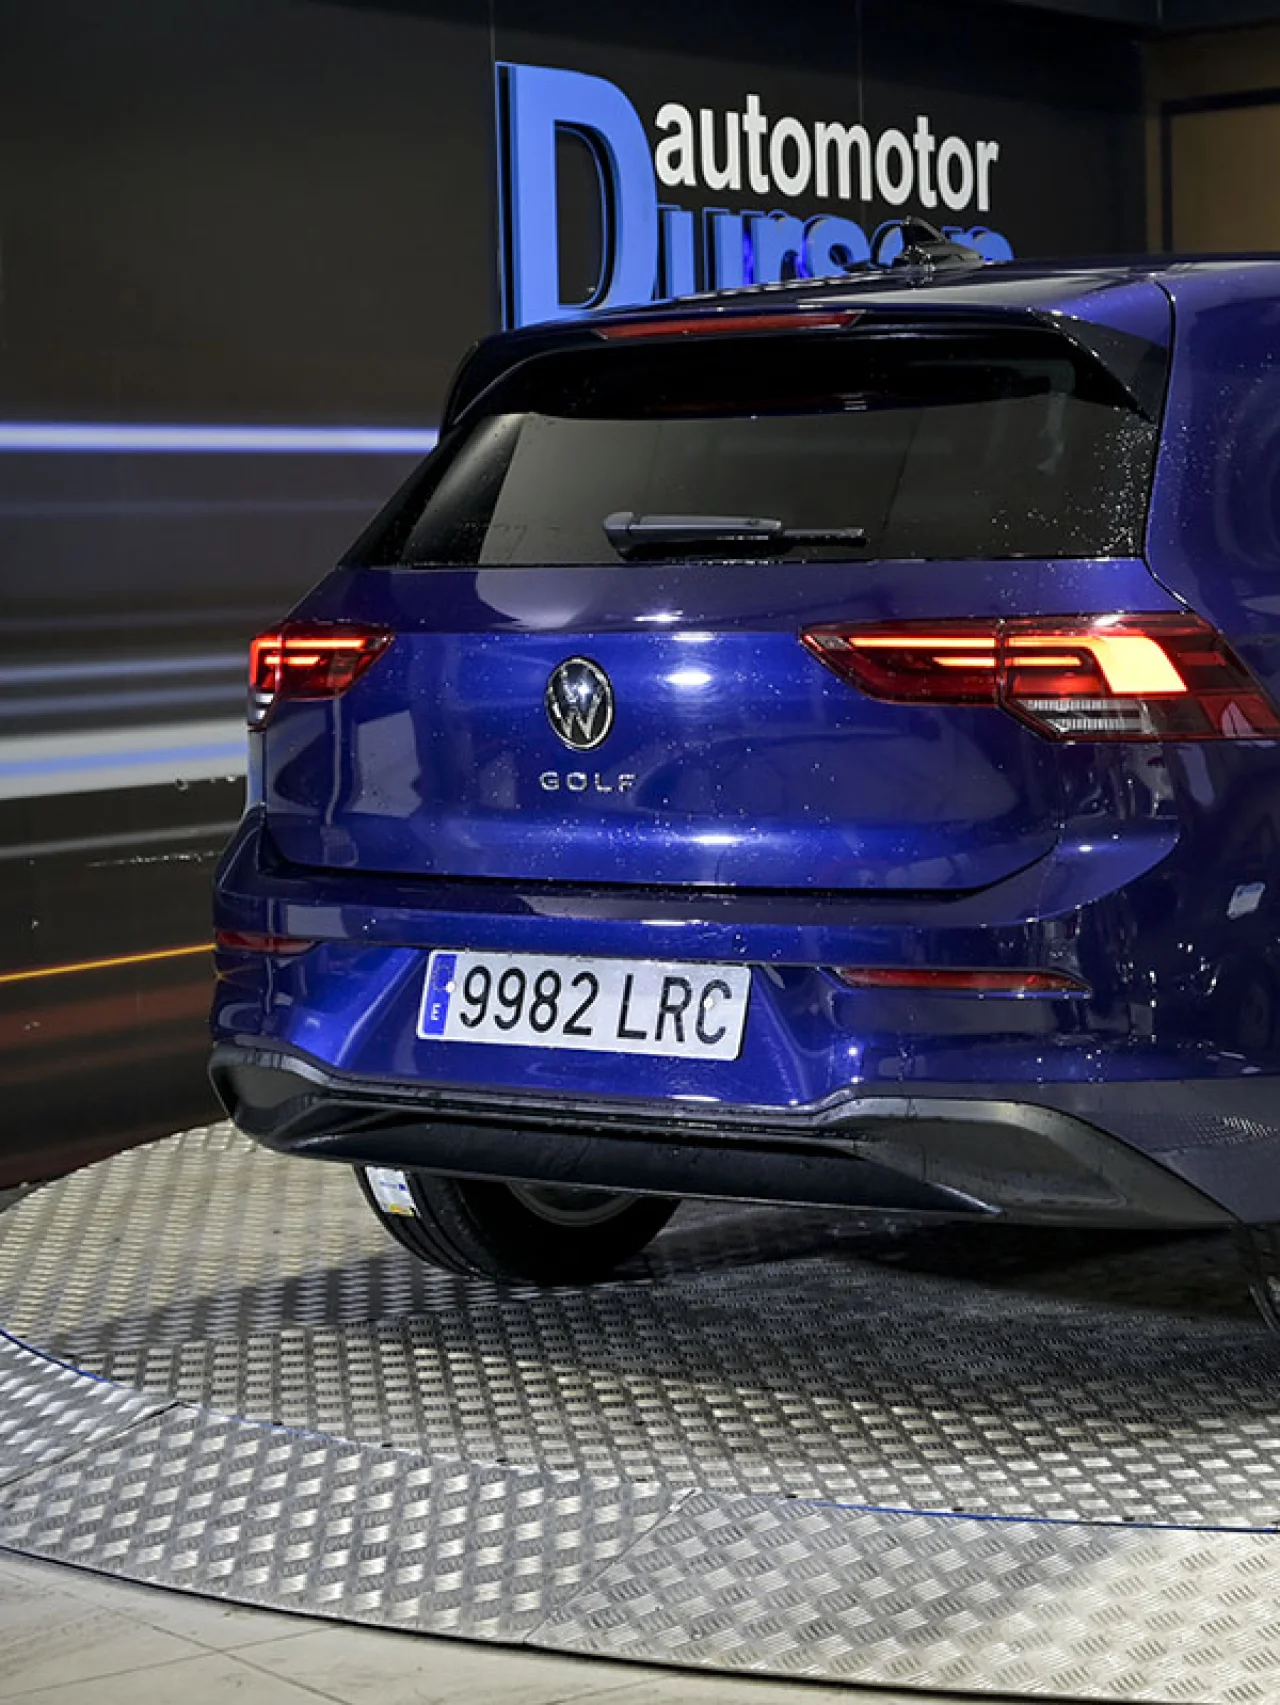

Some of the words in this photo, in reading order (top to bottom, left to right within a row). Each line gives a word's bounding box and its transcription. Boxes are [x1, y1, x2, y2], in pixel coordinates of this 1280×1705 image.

[655, 93, 999, 212] automotor
[539, 771, 638, 793] GOLF
[430, 1002, 442, 1022] E
[459, 965, 599, 1037] 9982
[616, 973, 733, 1045] LRC
